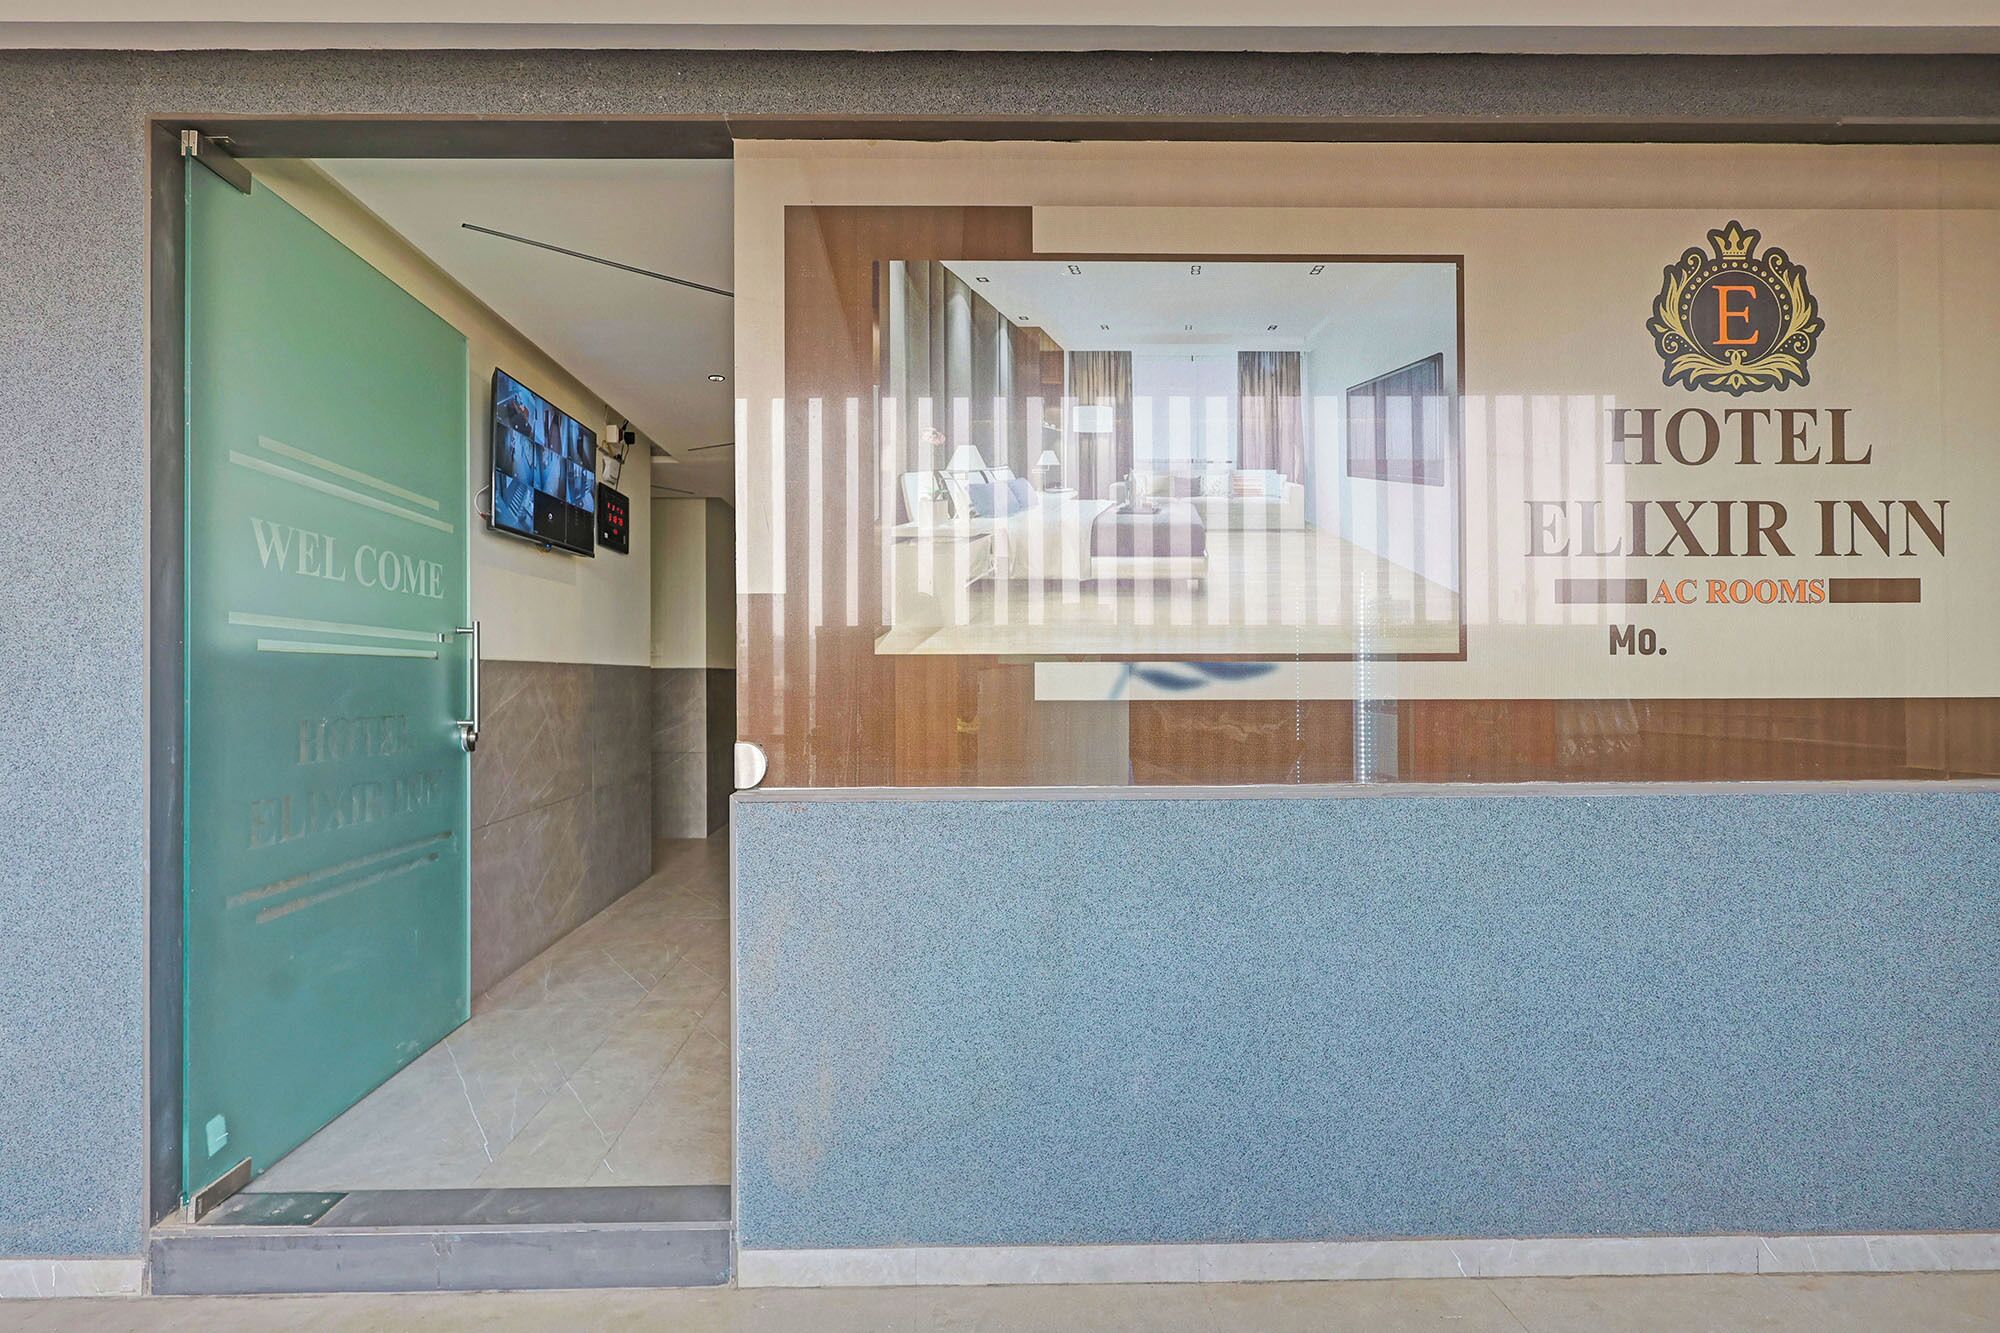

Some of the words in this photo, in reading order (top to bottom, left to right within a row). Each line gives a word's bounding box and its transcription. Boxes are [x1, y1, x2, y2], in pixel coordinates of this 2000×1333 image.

[1712, 285, 1759, 345] E
[1604, 408, 1873, 465] HOTEL
[1523, 500, 1796, 557] ELIXIR
[1814, 500, 1950, 557] INN
[1651, 578, 1698, 604] AC
[1705, 578, 1826, 604] ROOMS
